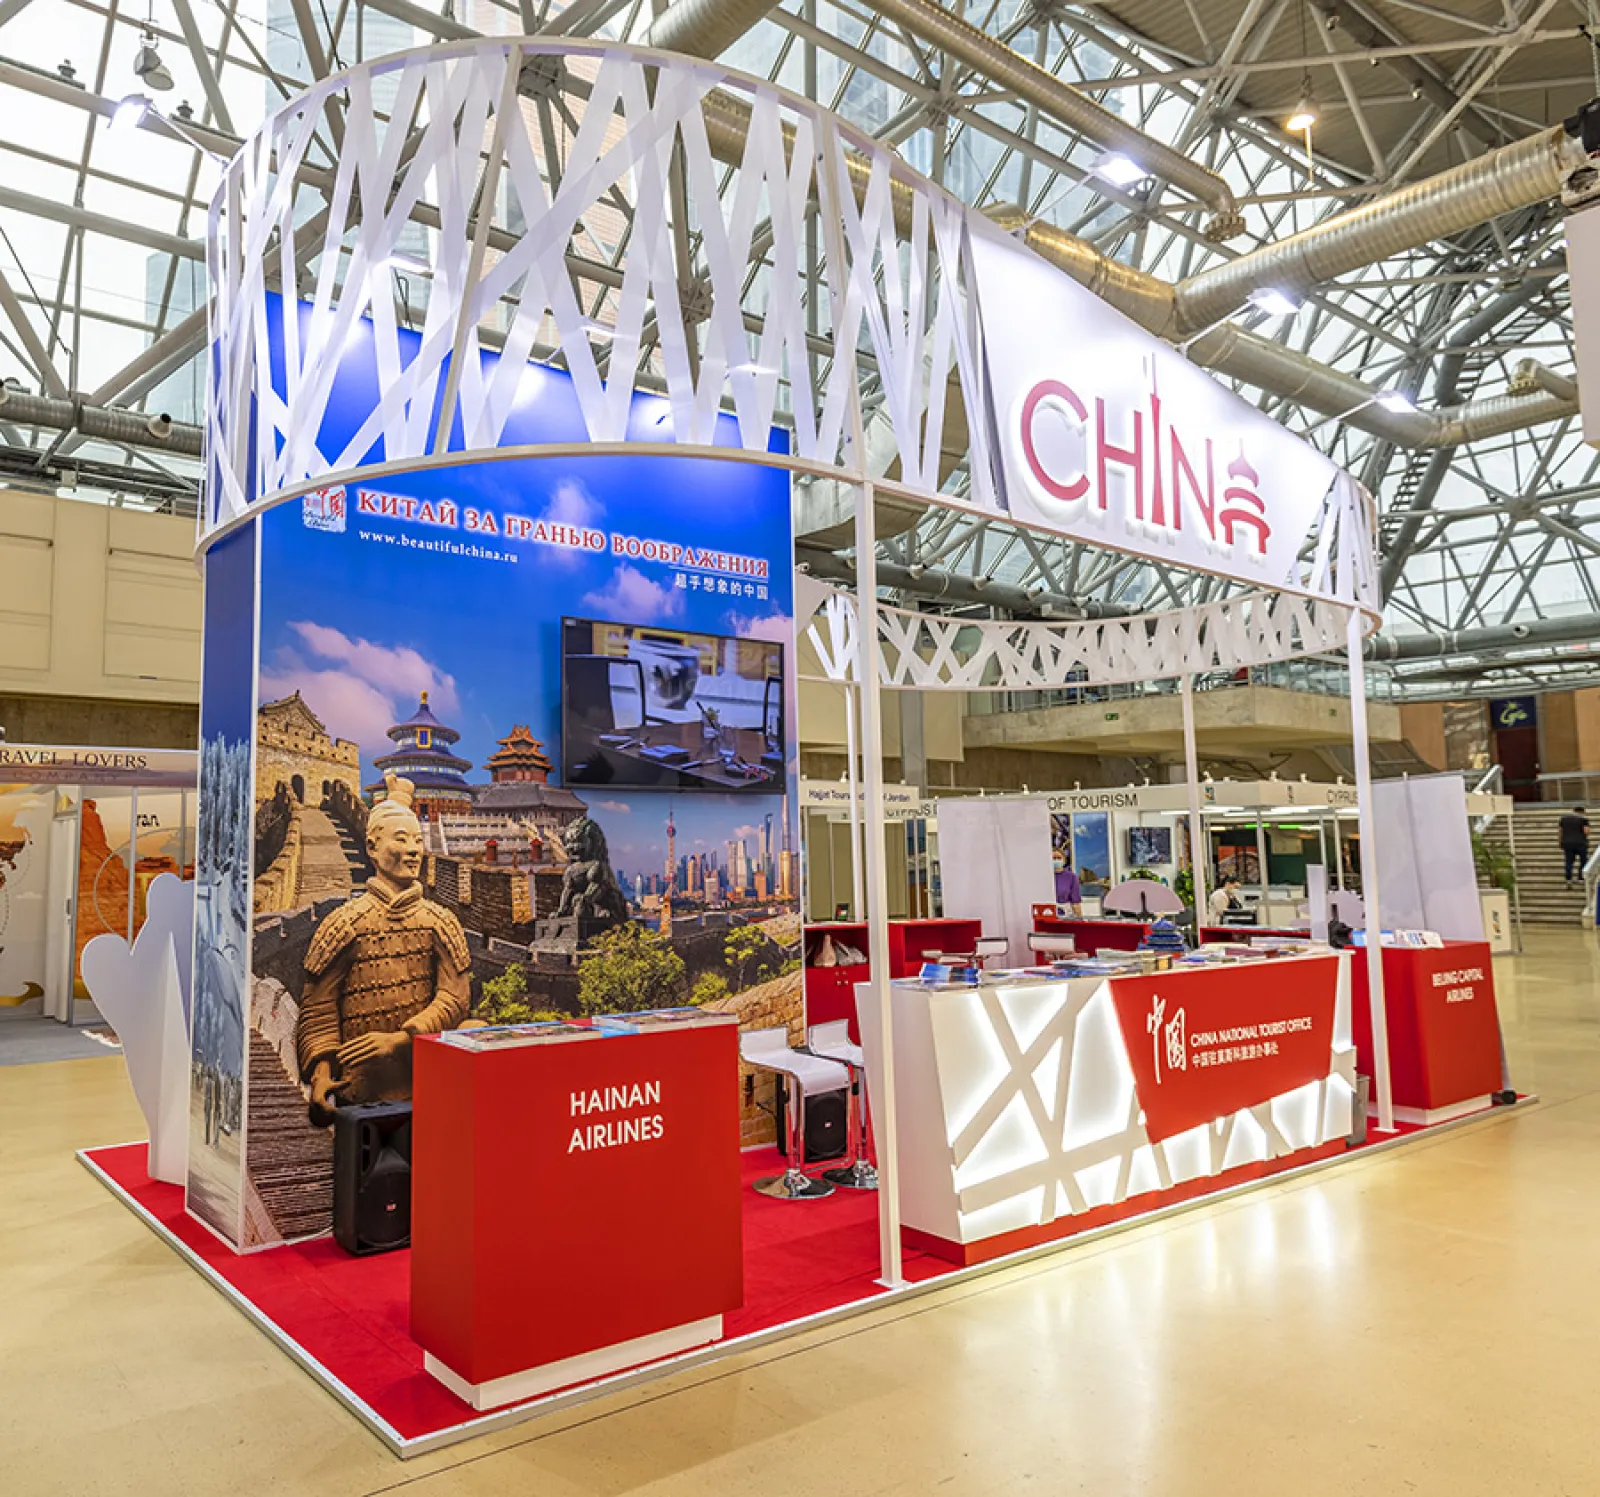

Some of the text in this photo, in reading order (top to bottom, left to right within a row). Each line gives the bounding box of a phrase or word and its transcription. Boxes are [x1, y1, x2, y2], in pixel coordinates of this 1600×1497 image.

[1021, 353, 1272, 554] CHINA
[358, 529, 519, 563] www.beautifulchina.ru
[359, 490, 456, 527] КИТАЙ
[464, 508, 497, 534] ЗА
[505, 516, 606, 551] ГРАНЬЮ
[613, 535, 769, 578] ВООБРАЖЕНИЯ
[72, 751, 148, 770] LOVERS
[1047, 793, 1139, 810] OF TOURISM
[1190, 1016, 1312, 1047] CHINA NATIONAL TOURIST OFFICE
[570, 1080, 661, 1117] HAINAN
[567, 1114, 664, 1154] AIRLINES
